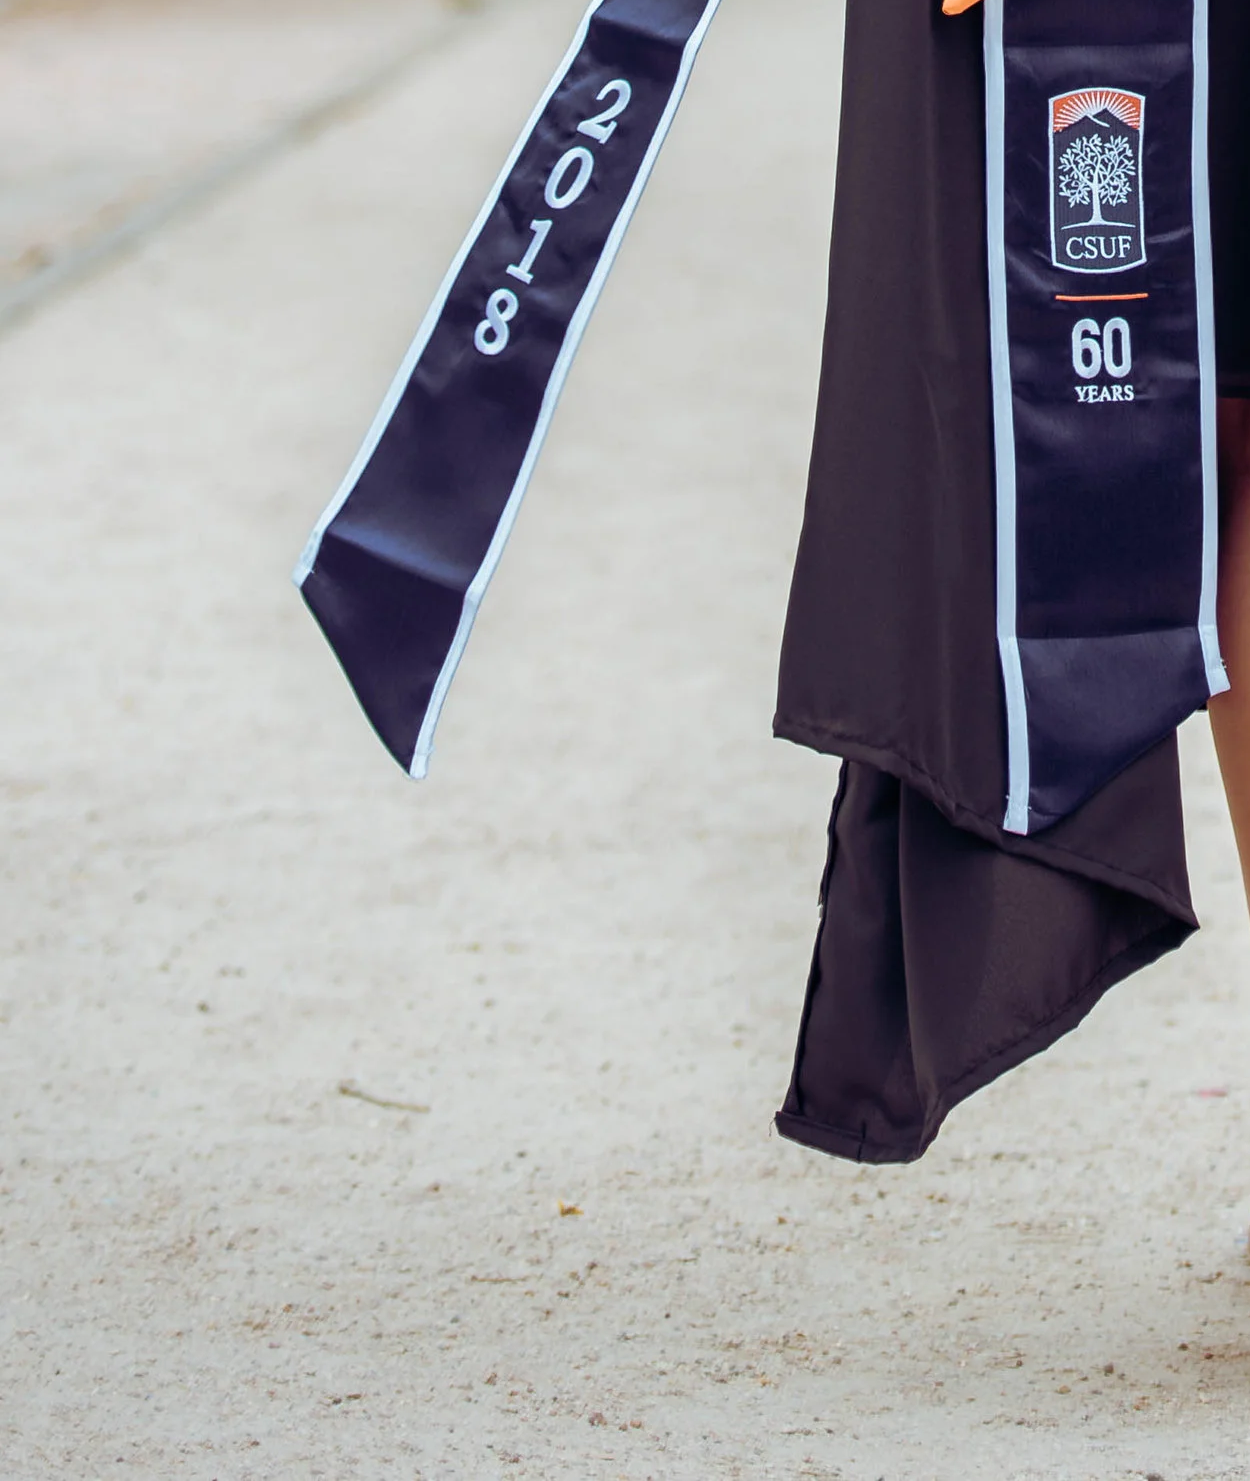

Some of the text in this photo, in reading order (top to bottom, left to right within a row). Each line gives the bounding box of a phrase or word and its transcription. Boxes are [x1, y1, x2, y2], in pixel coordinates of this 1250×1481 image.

[473, 78, 633, 356] 2018
[1066, 235, 1132, 259] CSUF
[1072, 317, 1132, 379] 60
[1075, 385, 1134, 403] YEARS
